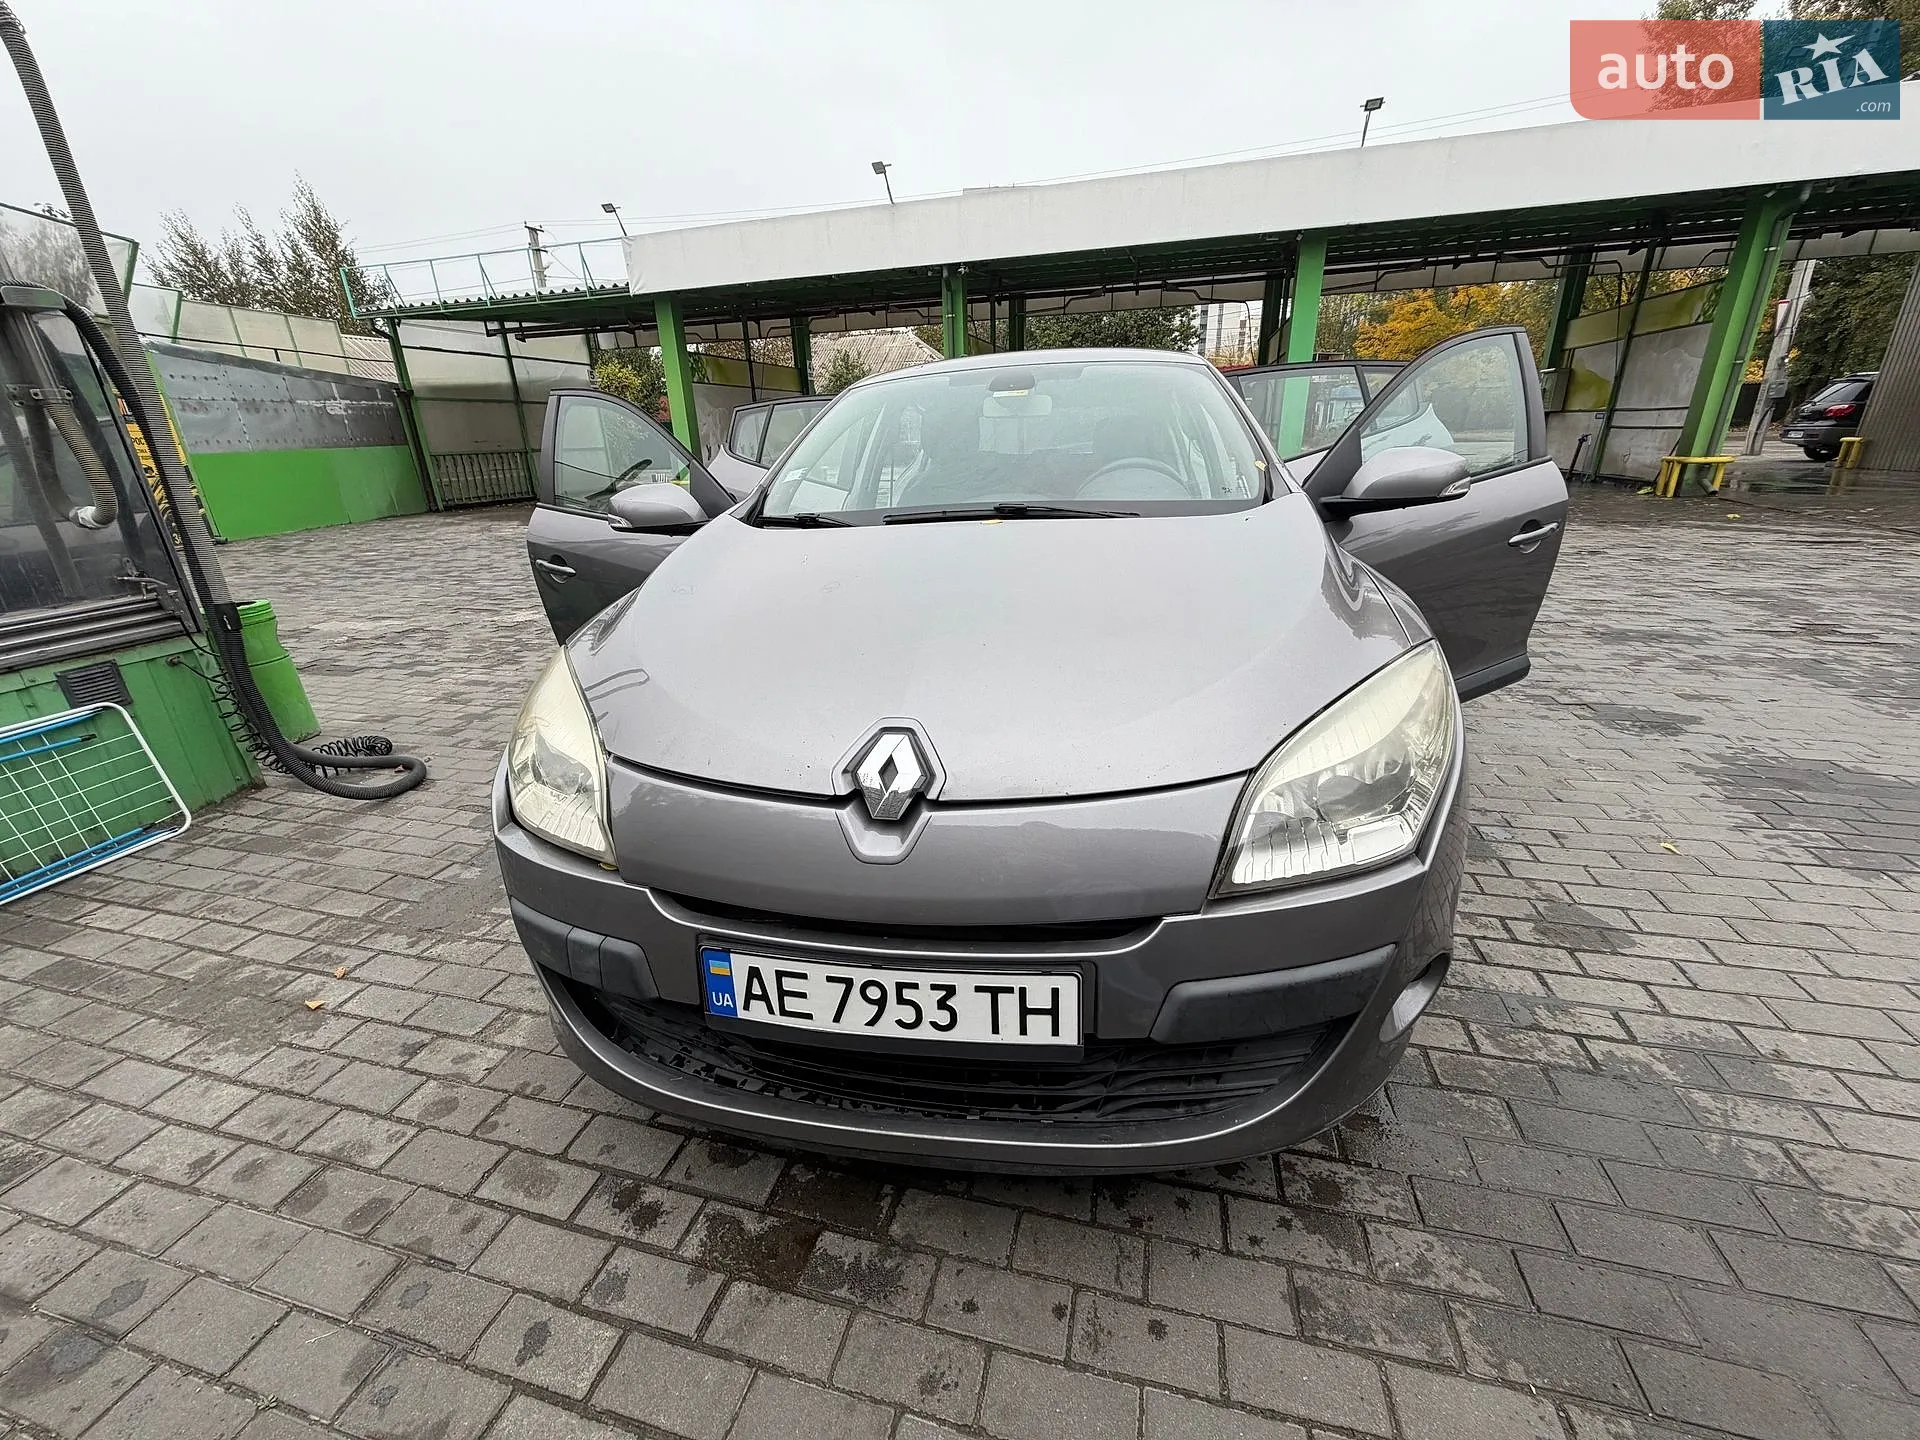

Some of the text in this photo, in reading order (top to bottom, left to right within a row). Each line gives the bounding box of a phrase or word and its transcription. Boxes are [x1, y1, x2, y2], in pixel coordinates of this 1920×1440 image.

[711, 991, 734, 1008] UA
[743, 965, 1060, 1037] AE 7953 TH
